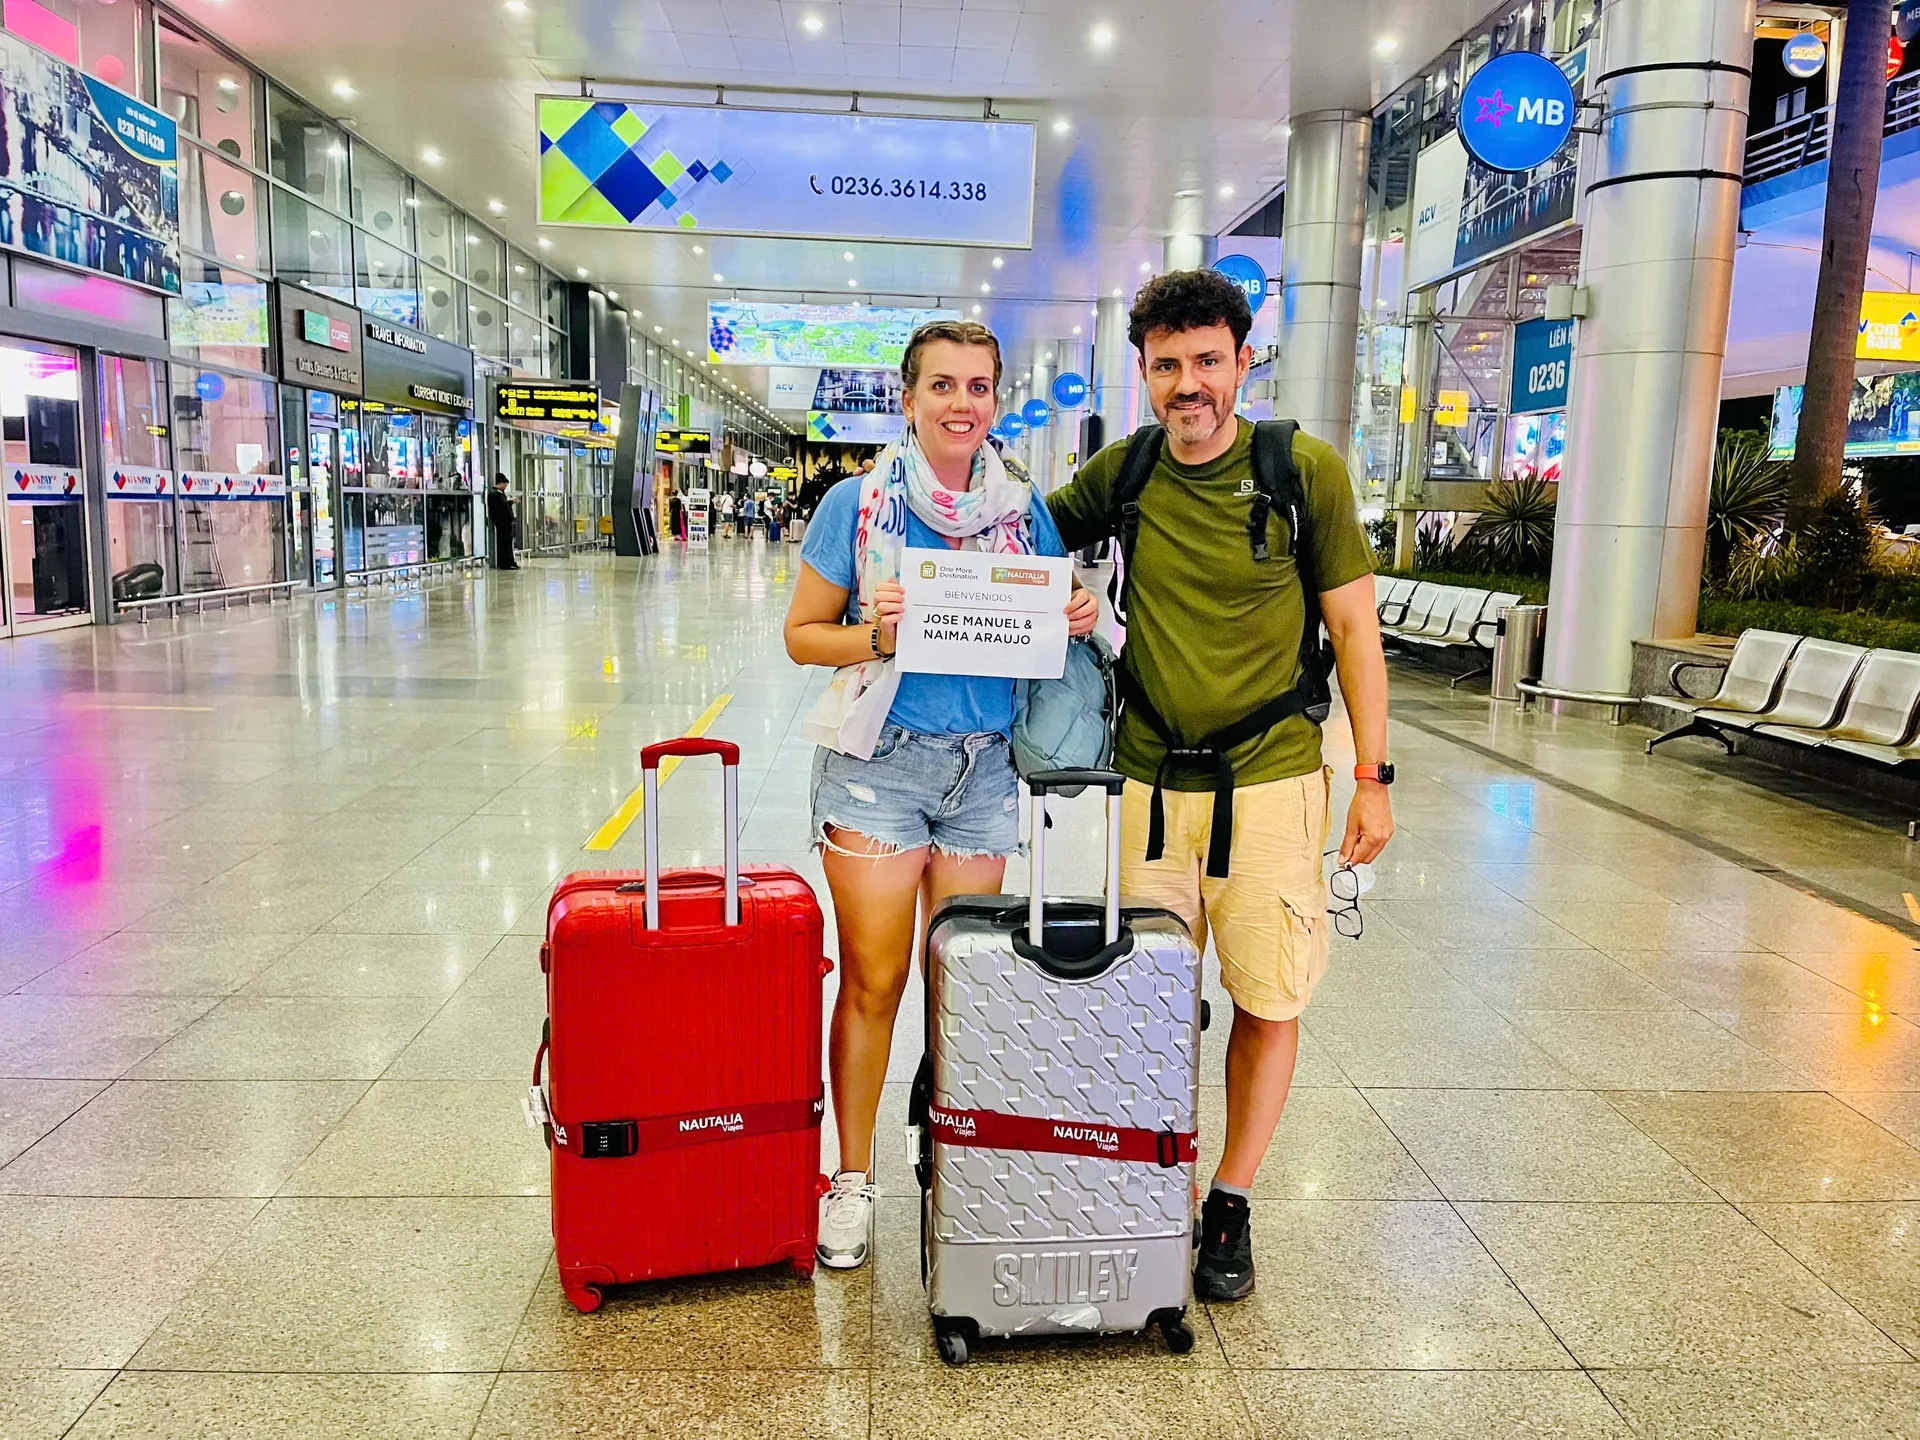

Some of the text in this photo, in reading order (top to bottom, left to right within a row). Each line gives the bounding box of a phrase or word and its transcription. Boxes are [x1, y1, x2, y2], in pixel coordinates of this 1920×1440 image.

[1516, 96, 1565, 126] MB
[831, 175, 987, 201] 0236.3614.338
[1418, 204, 1437, 226] ACV
[330, 328, 349, 343] COFFEE
[371, 324, 427, 354] TRAVEL INFORMATION
[1528, 359, 1566, 394] 0236
[413, 384, 438, 402] CURRENCY
[438, 391, 453, 405] MONEY
[775, 383, 794, 391] ACV
[1068, 384, 1084, 394] MB
[940, 572, 979, 580] Destination
[1007, 571, 1045, 581] NAUTALIA
[944, 590, 1013, 603] BIENVENIDOS
[923, 613, 1033, 630] JOSE MANUEL &
[923, 629, 1031, 645] NAIMA ARAUJO
[679, 1112, 744, 1132] NAUTALIA
[722, 1124, 744, 1132] Viajes
[953, 1127, 977, 1137] Viajes
[1053, 1125, 1119, 1144] NAUTALIA
[1096, 1141, 1119, 1152] Viajes
[993, 1249, 1139, 1307] SMILEY
